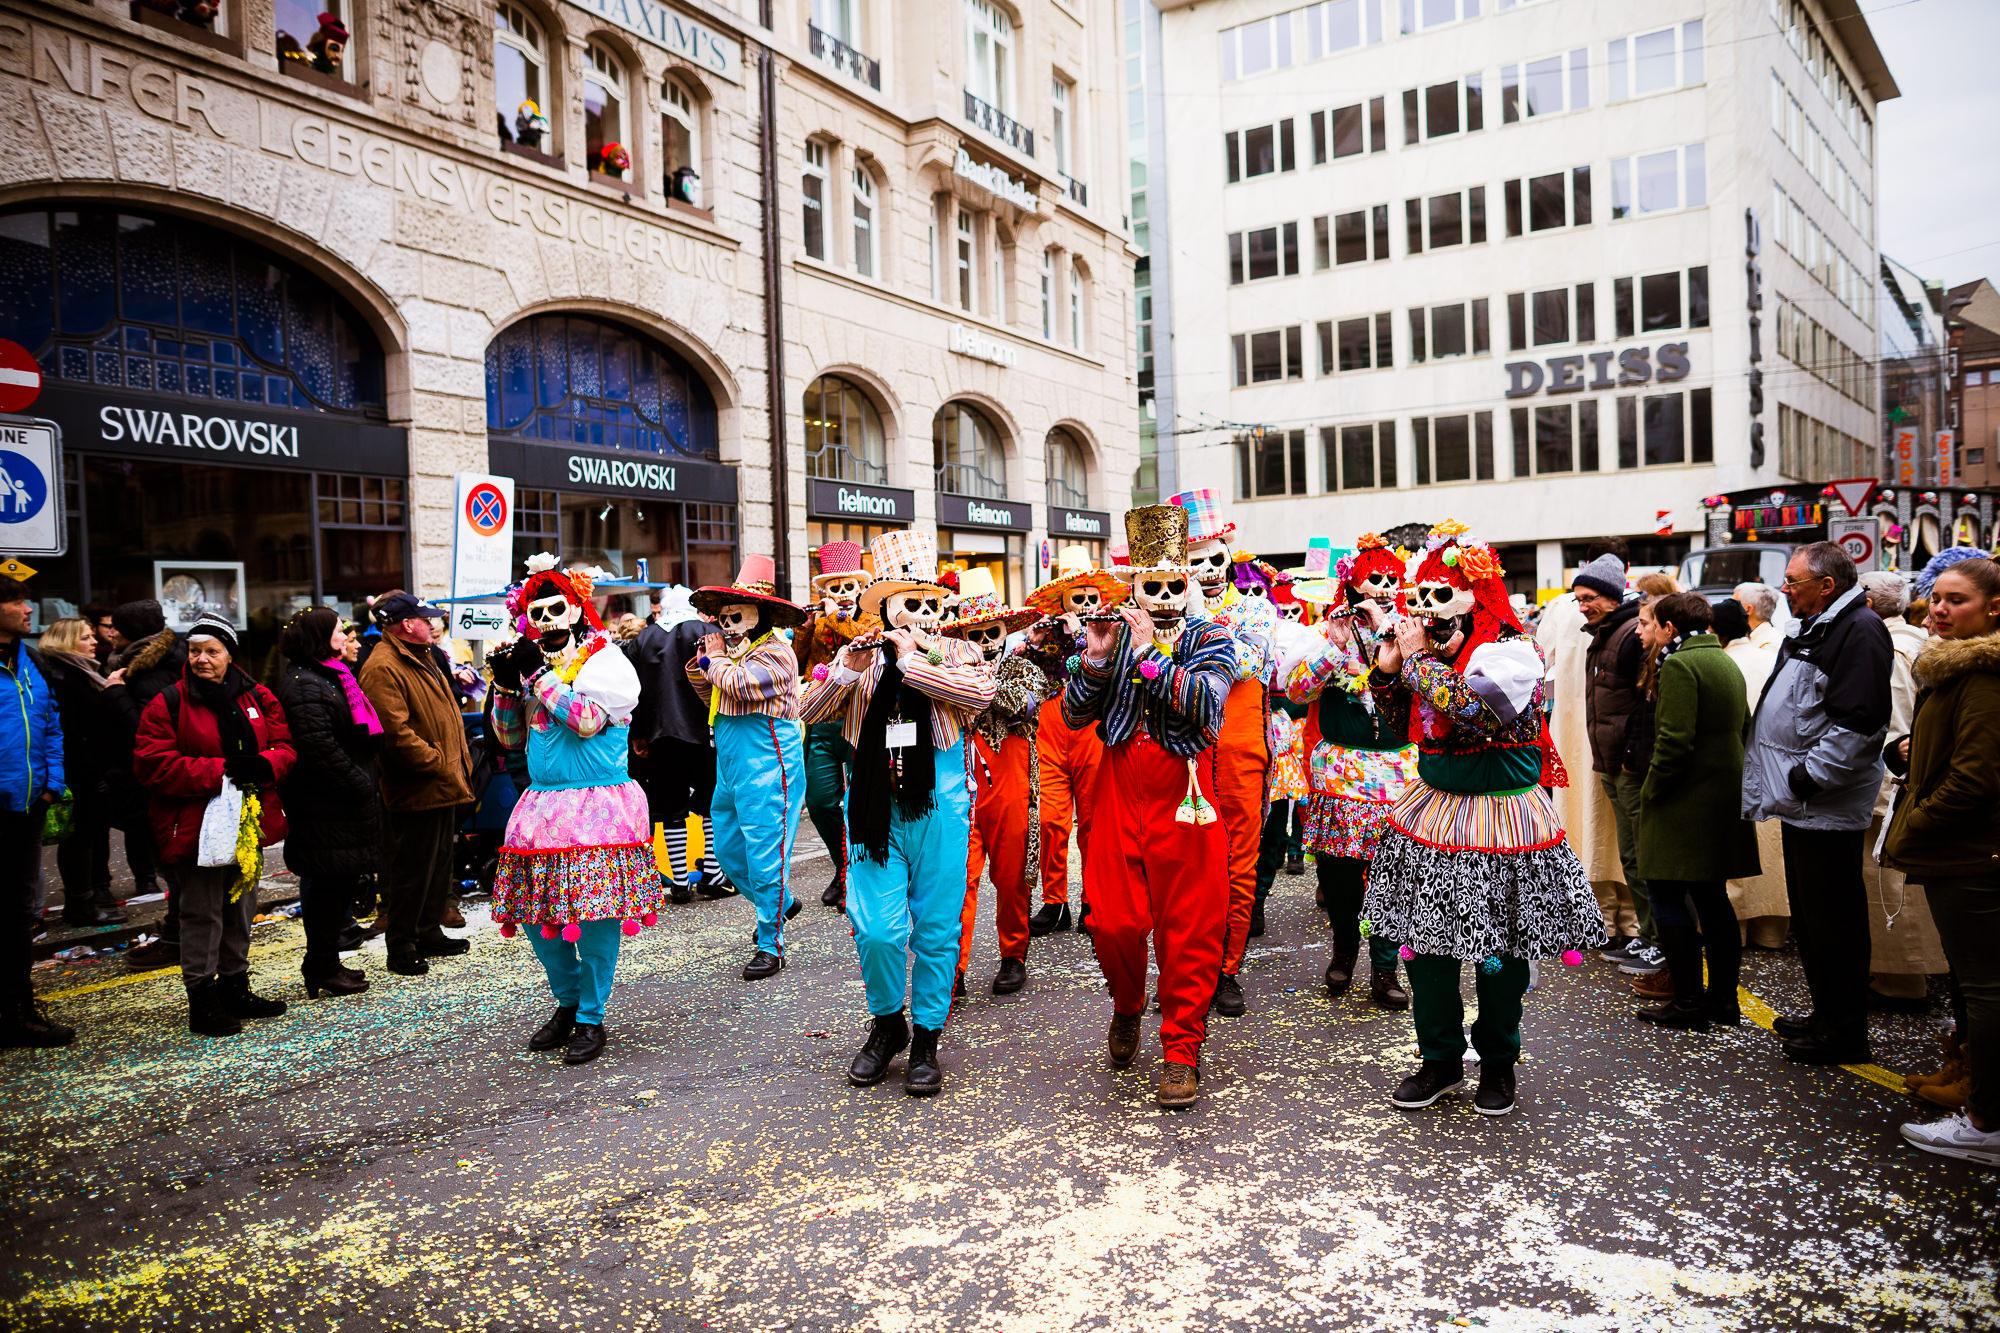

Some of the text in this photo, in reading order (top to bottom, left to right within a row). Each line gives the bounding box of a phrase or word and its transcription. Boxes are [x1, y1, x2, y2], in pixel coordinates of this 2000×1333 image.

[258, 99, 735, 287] LEBENSVERSICHERUNG
[1505, 341, 1691, 399] DEISS
[0, 430, 28, 444] NE
[100, 406, 299, 457] SWAROVSKI
[568, 456, 676, 491] SWAROVSKI
[1848, 542, 1862, 555] 30
